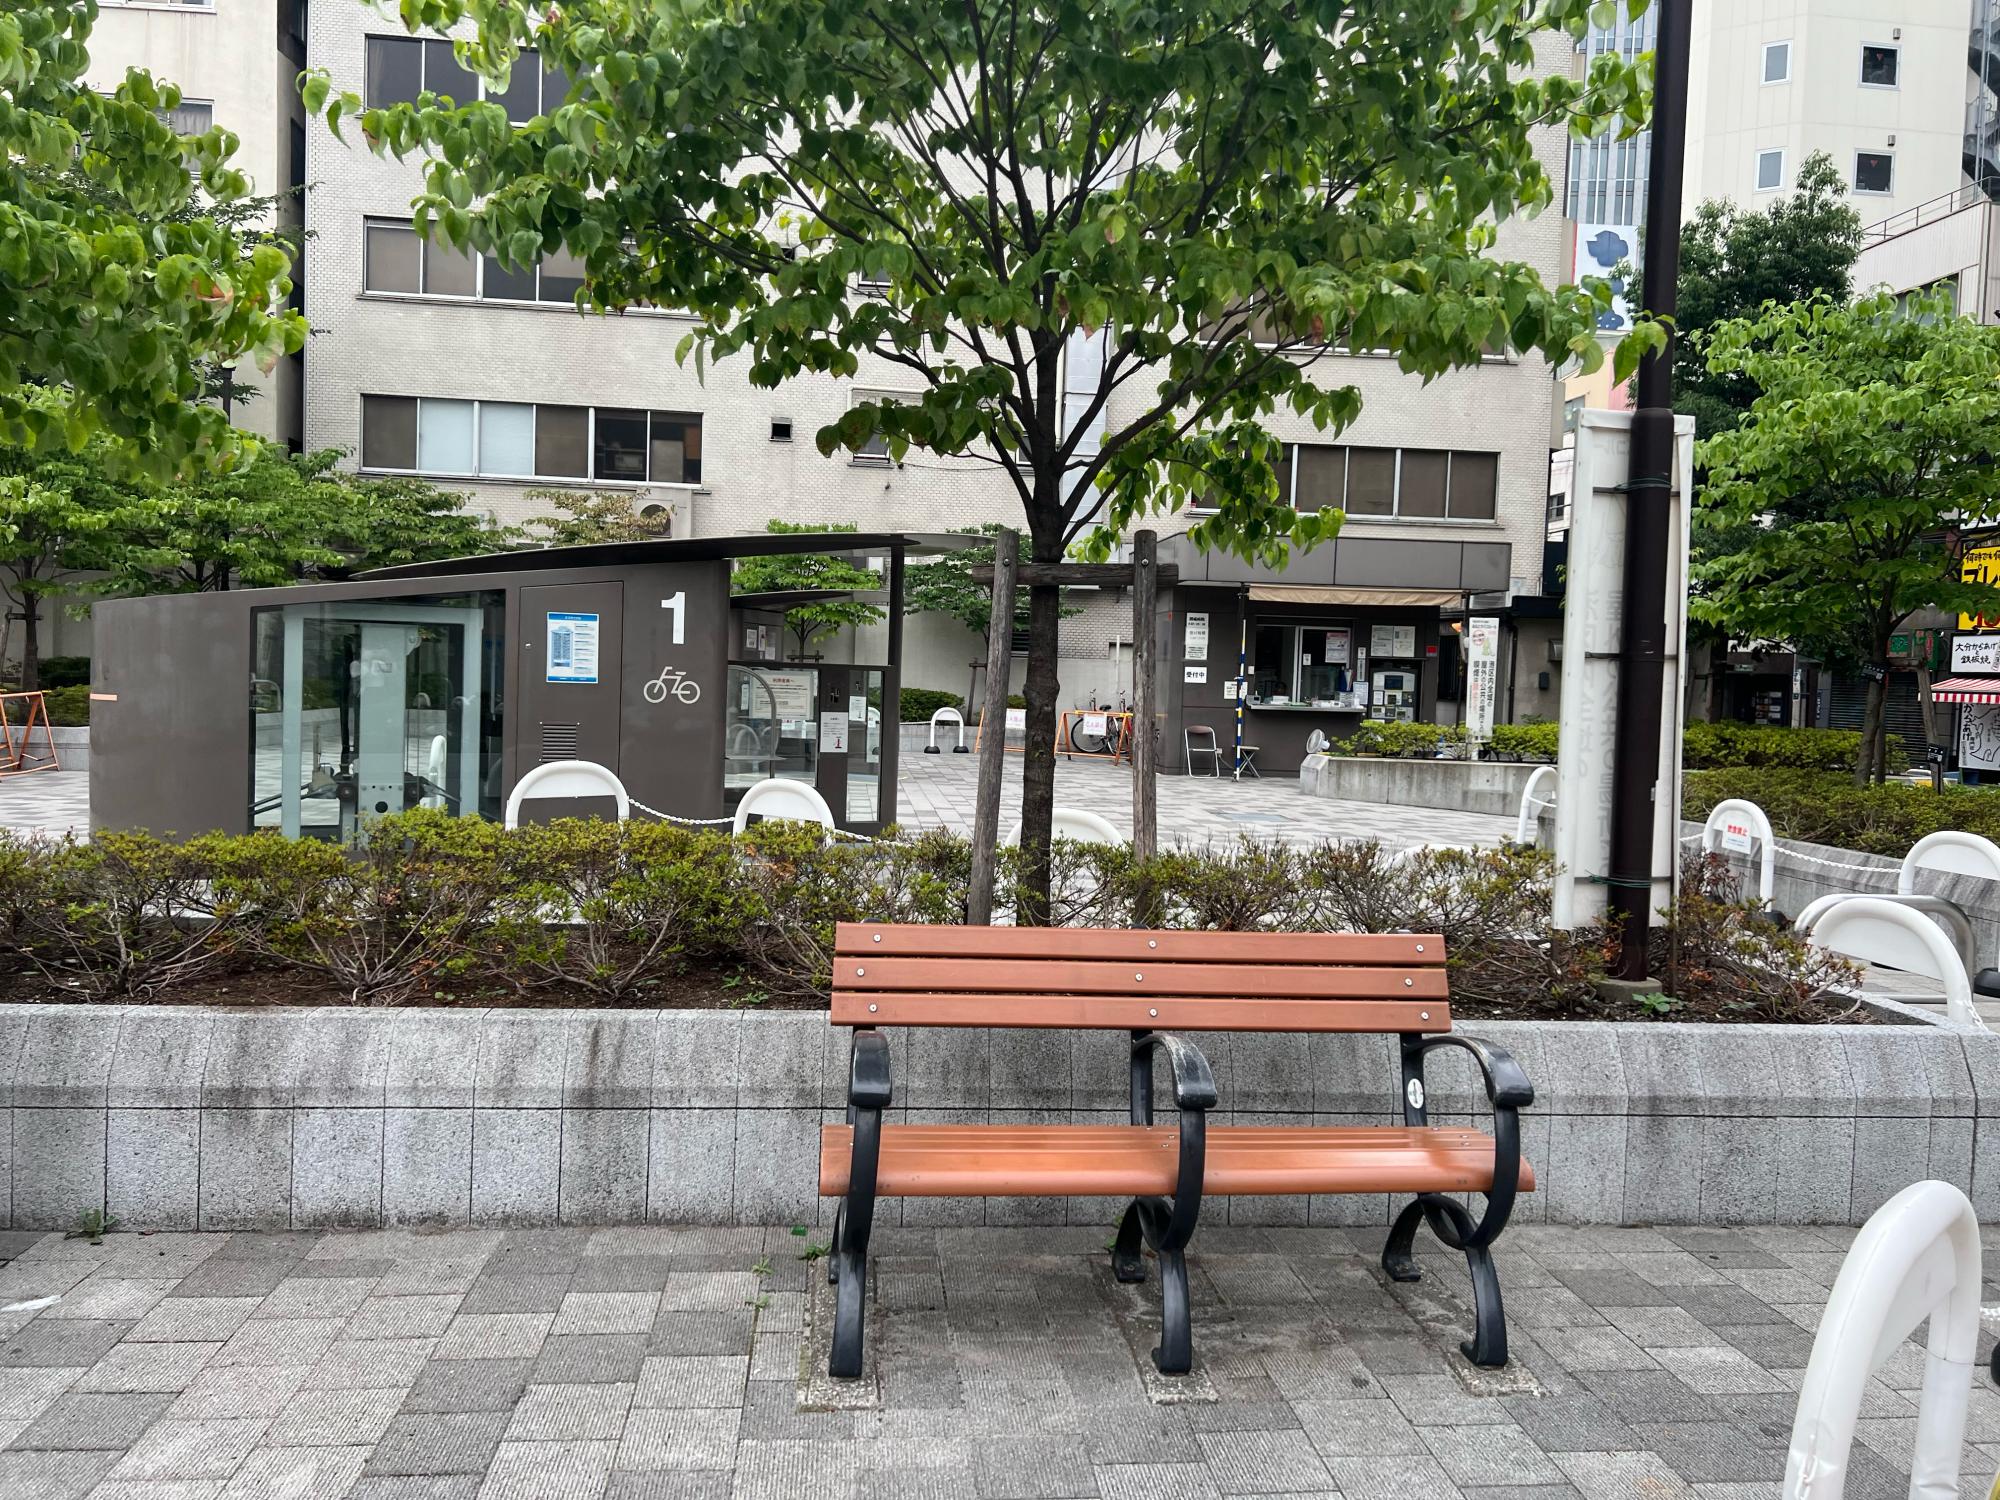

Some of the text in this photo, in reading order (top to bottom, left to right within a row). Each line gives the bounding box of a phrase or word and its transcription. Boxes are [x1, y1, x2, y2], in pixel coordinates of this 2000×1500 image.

[1964, 564, 2000, 588] プレ
[661, 591, 685, 645] 1
[1186, 671, 1205, 679] 受付中
